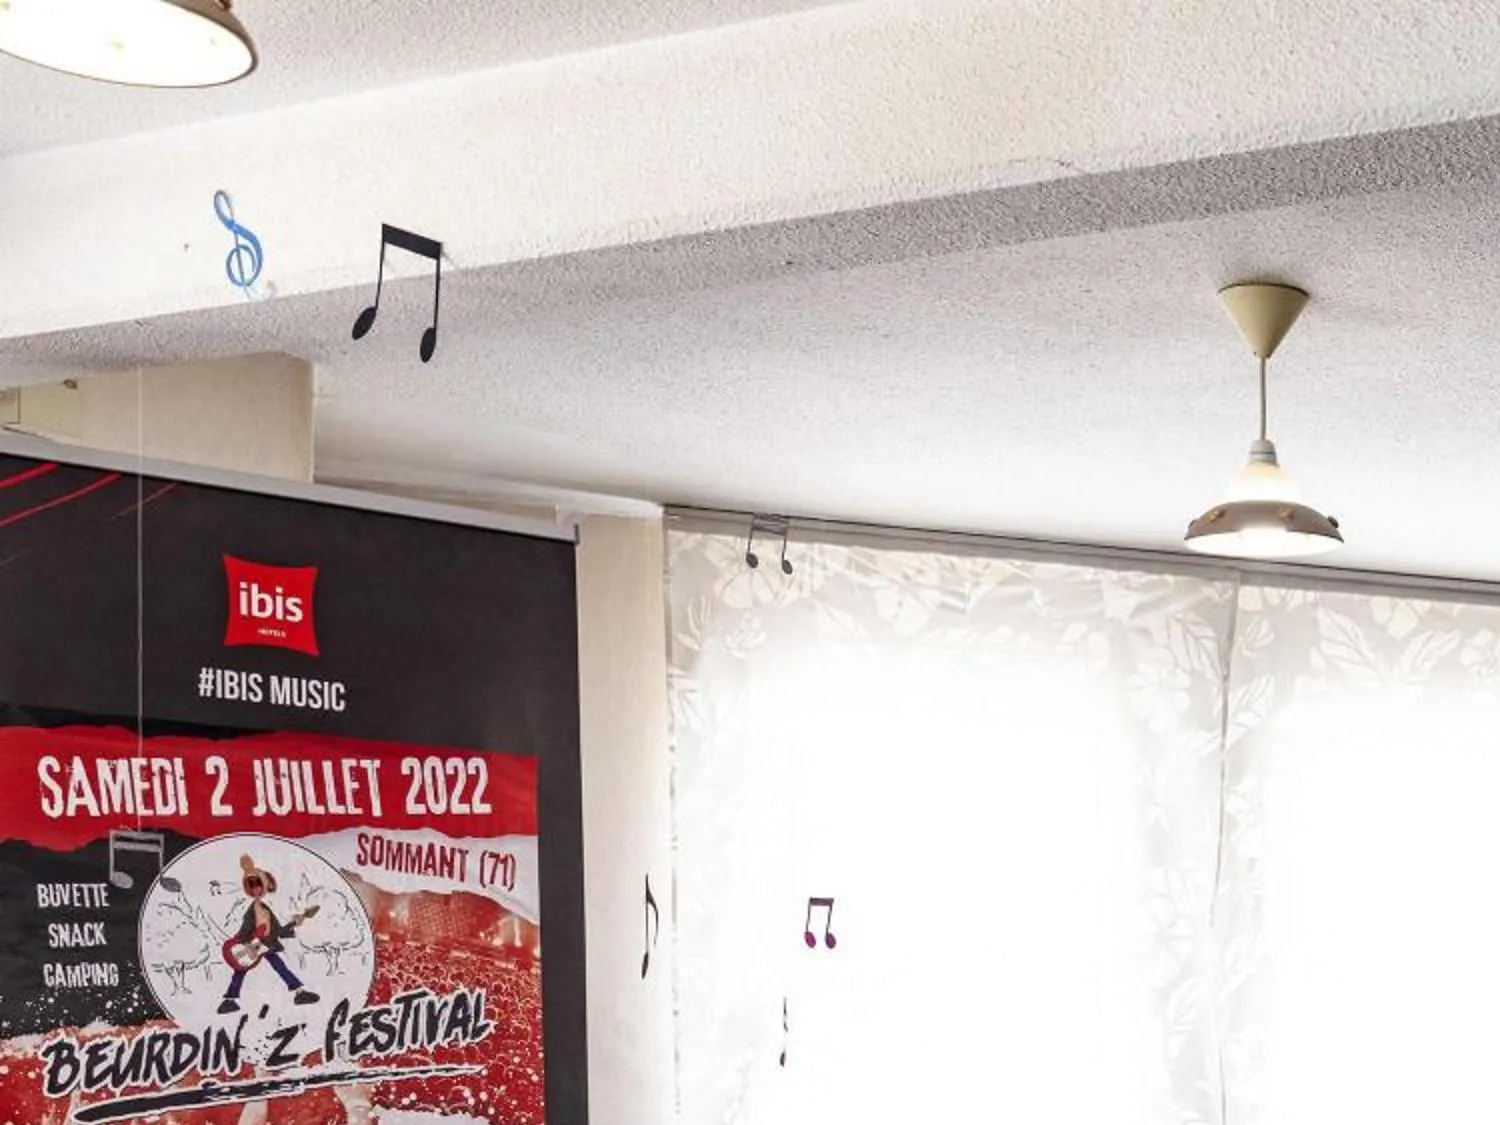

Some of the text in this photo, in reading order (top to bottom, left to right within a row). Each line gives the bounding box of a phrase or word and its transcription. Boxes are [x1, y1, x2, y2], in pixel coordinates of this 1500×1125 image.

[239, 581, 303, 622] ibis
[199, 668, 346, 712] #IBIS MUSIC
[37, 756, 492, 818] SAMEDI 2 JUILLET 2022
[356, 833, 518, 890] SOMMANT (71)
[36, 883, 110, 909] BUVETTE
[48, 922, 107, 948] SNACK
[43, 961, 119, 988] CAMPING
